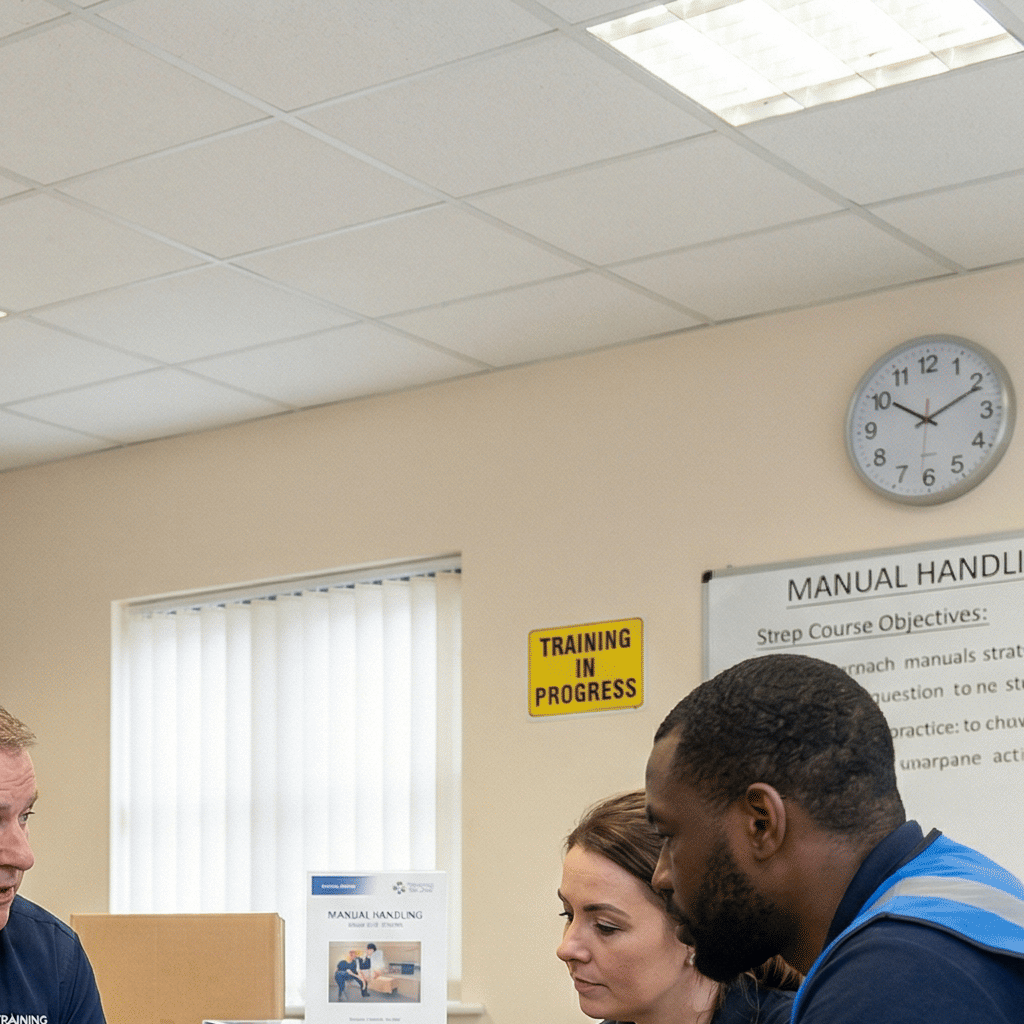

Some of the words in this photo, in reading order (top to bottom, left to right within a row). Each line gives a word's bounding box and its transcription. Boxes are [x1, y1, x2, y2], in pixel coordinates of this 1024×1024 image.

[918, 354, 938, 374] 12
[952, 357, 960, 375] 1
[892, 367, 908, 387] 11
[970, 372, 983, 392] 2
[871, 391, 892, 411] 10
[980, 400, 993, 419] 3
[864, 422, 877, 440] 9
[971, 431, 985, 448] 4
[873, 448, 886, 467] 8
[950, 455, 964, 474] 5
[895, 465, 909, 484] 7
[922, 468, 936, 487] 6
[787, 565, 907, 601] MANUAL
[917, 549, 1023, 586] HANDLI
[757, 628, 803, 645] Strep
[808, 621, 873, 640] Course
[878, 607, 987, 634] Objectives:
[539, 627, 631, 657] TRAINING
[904, 647, 976, 669] manuals
[982, 645, 1024, 662] strat
[576, 657, 595, 678] IN
[535, 677, 637, 708] PROGRESS
[954, 683, 972, 697] to
[964, 719, 981, 732] to
[327, 910, 370, 920] MANUAL
